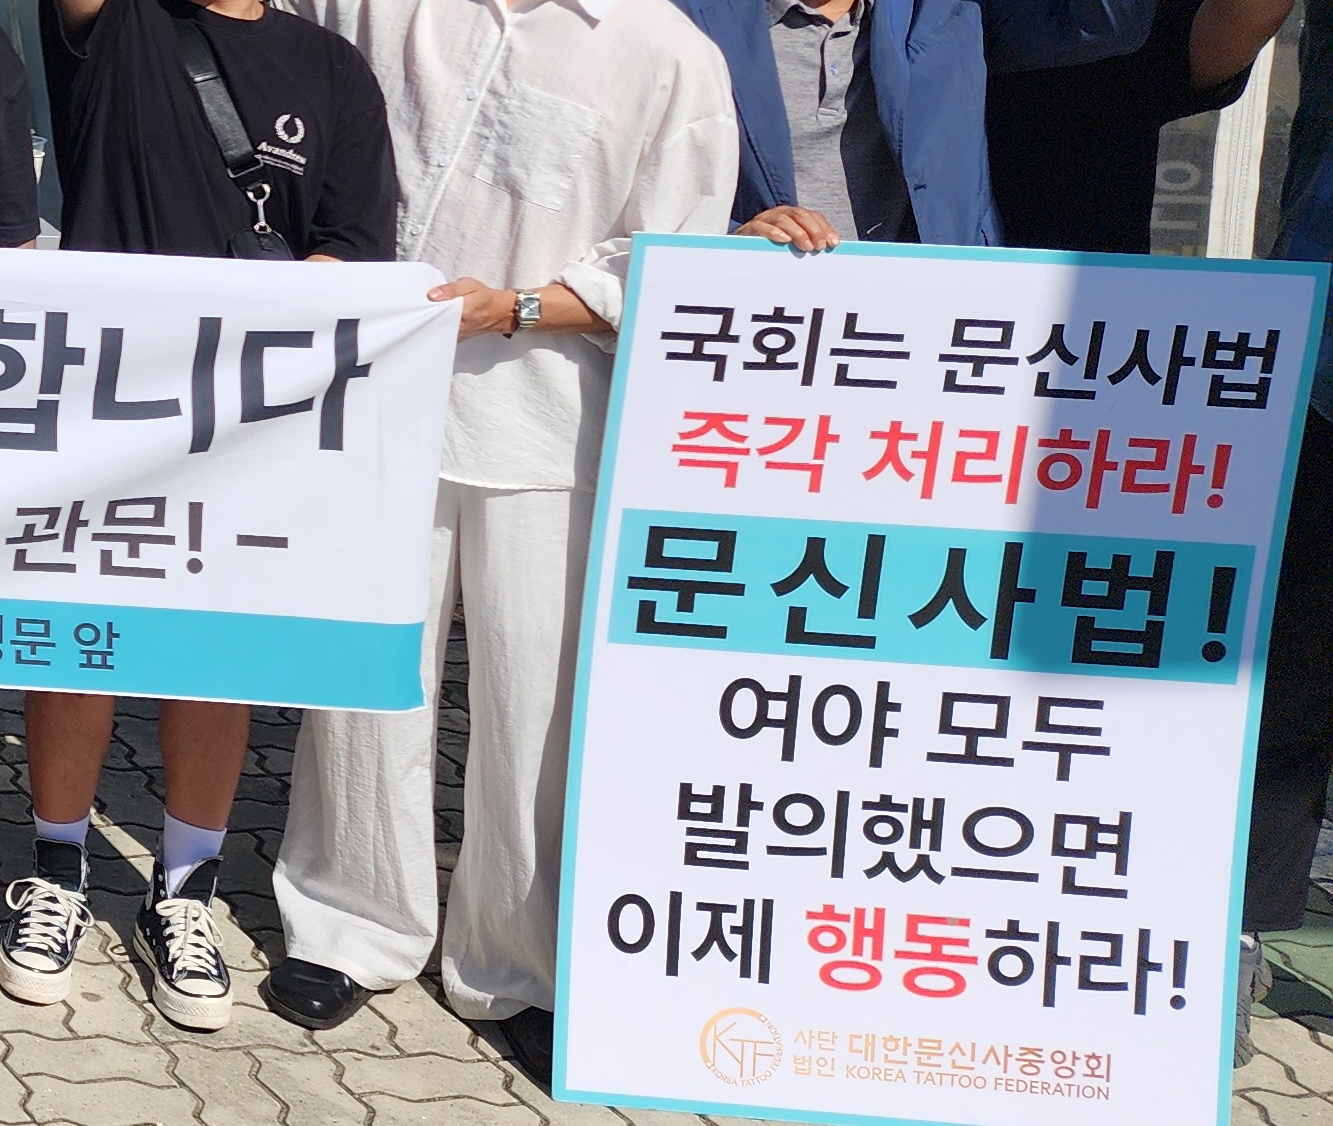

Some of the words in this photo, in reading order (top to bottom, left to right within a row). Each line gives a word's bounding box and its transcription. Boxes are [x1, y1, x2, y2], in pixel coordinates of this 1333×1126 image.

[660, 304, 911, 390] 국회는
[938, 317, 1281, 410] 문신사법
[670, 411, 841, 494] 즉각
[862, 419, 1233, 515] 처리하라!
[5, 496, 205, 580] 관문!
[73, 621, 120, 671] 앞
[719, 674, 901, 769] 여야
[925, 690, 1111, 782] 모두
[677, 781, 1133, 900] 발의했으면
[606, 891, 775, 984] 이제
[805, 903, 1190, 1016] 행동하라!
[792, 1054, 835, 1079] 법인
[793, 1028, 838, 1052] 사단
[847, 1032, 1112, 1083] 대한문신사중앙회
[845, 1064, 907, 1084] KOREA
[913, 1069, 987, 1090] TATTOO
[993, 1077, 1111, 1101] FEDERATION
